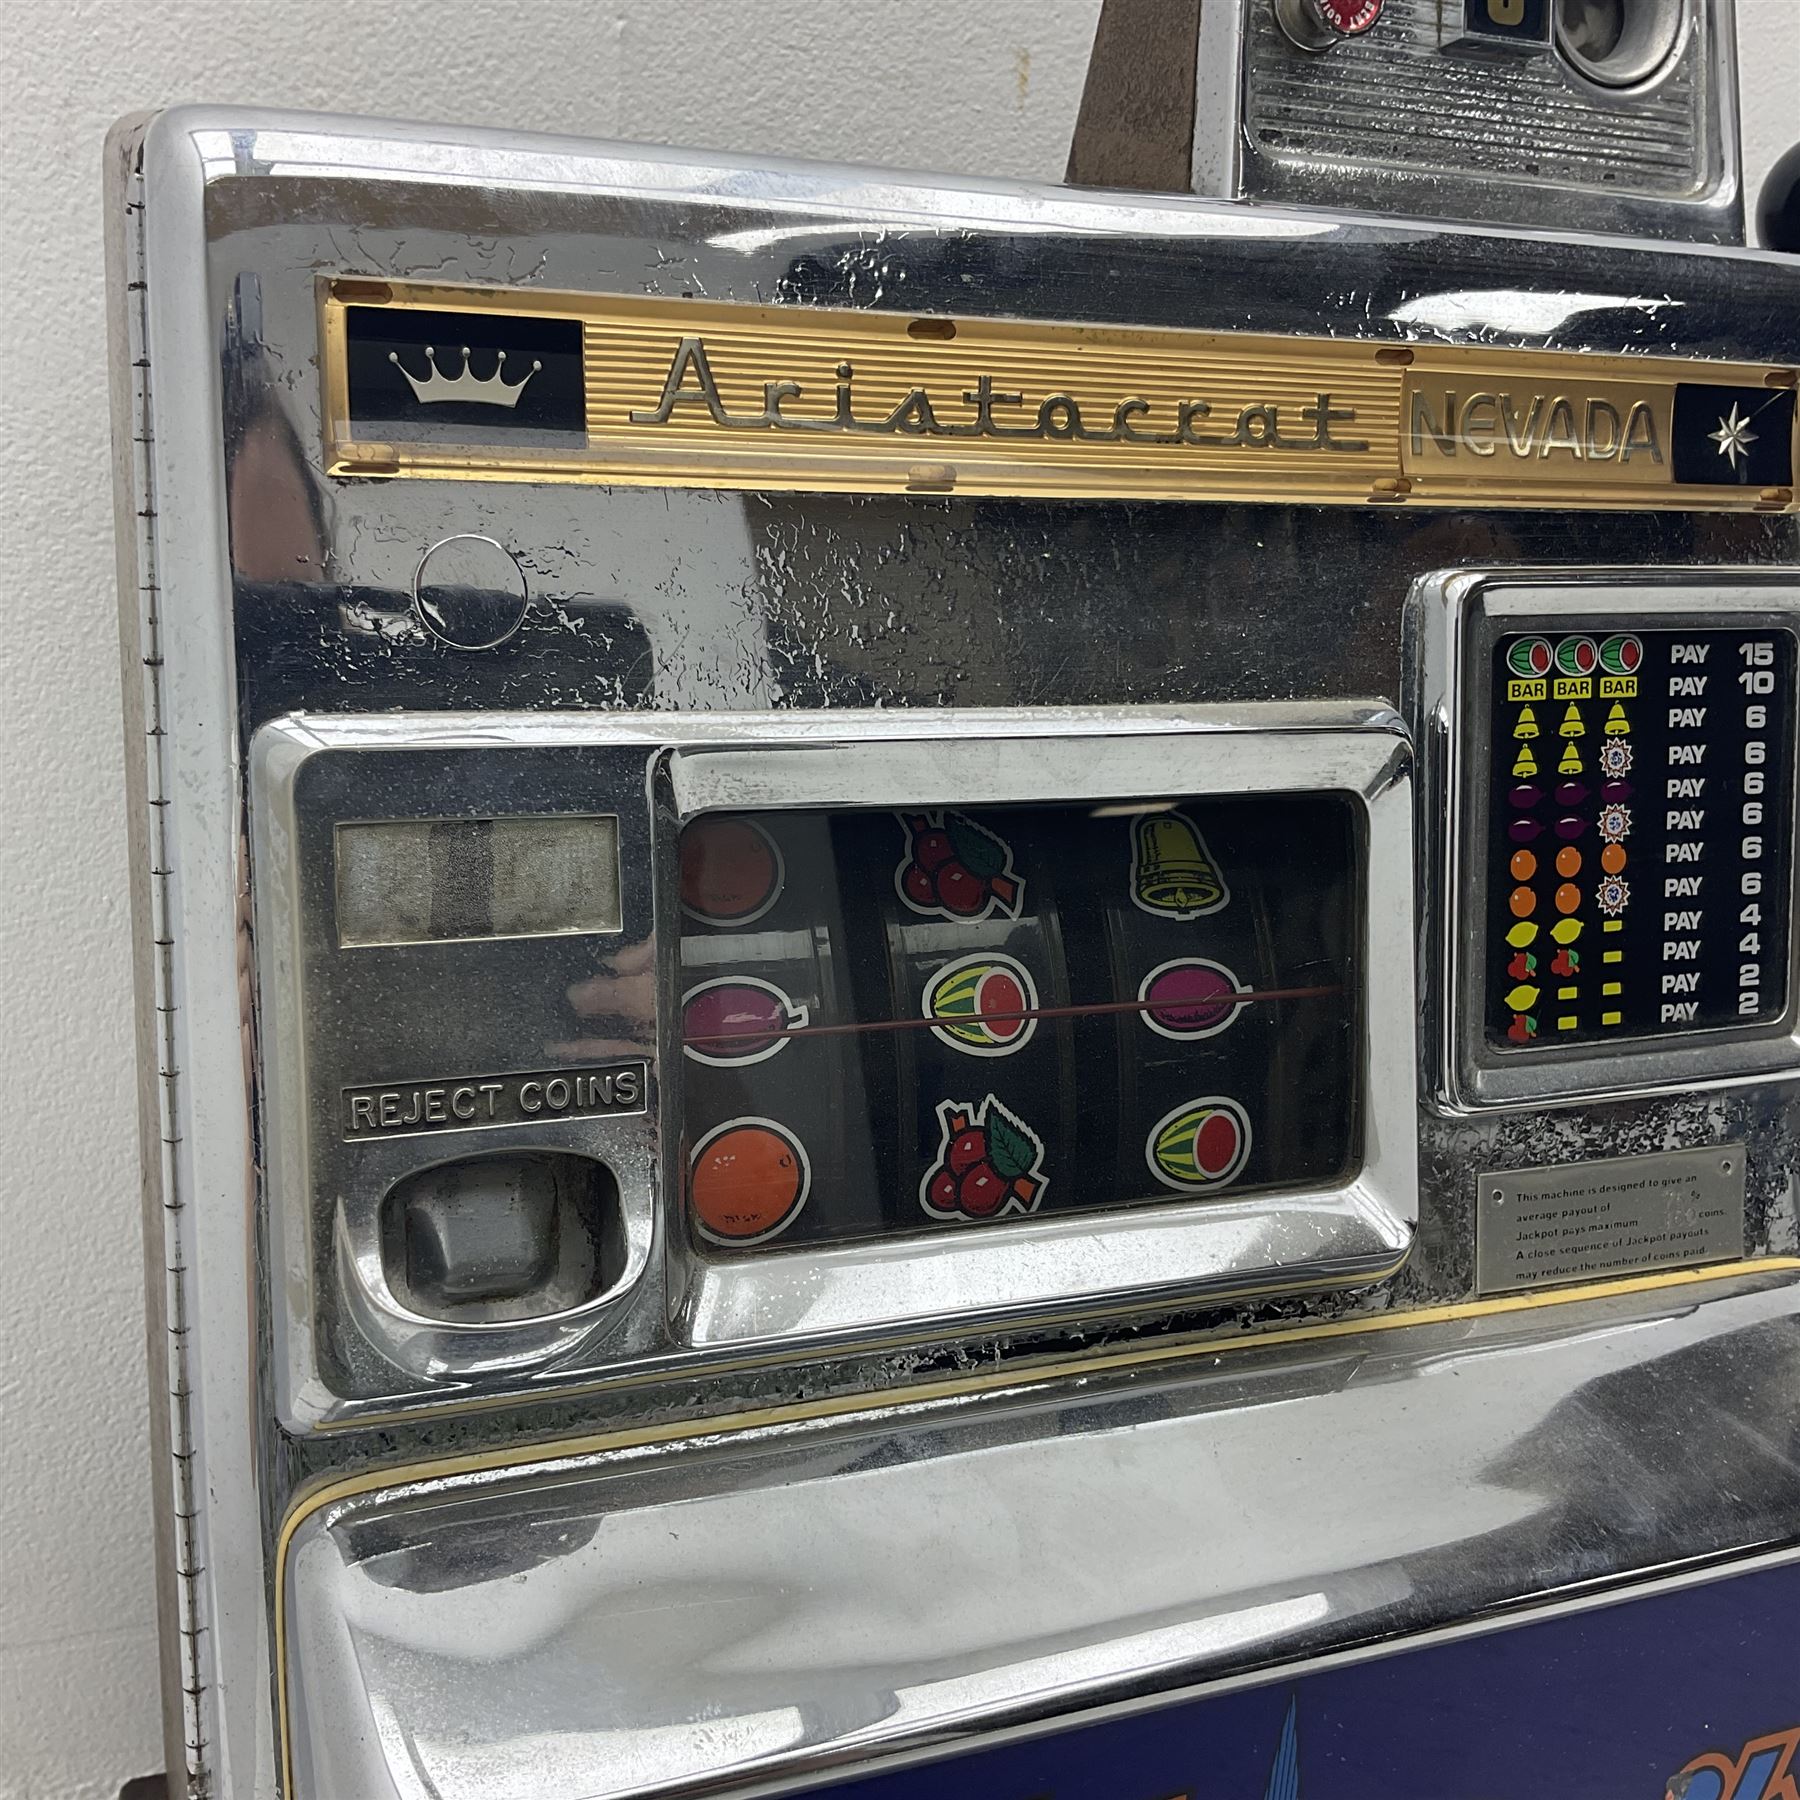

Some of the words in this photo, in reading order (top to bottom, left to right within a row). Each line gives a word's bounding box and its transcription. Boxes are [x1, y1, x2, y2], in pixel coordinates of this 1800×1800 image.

[629, 336, 1369, 453] Aristocrat
[1408, 389, 1664, 465] NEVADA
[1671, 645, 1710, 664] PAY
[1739, 643, 1773, 666] 15
[1511, 682, 1544, 697] BAR
[1557, 680, 1589, 696] BAR
[1603, 679, 1635, 694] BAR
[1669, 676, 1707, 696] PAY
[1738, 671, 1774, 695] 10
[1668, 707, 1707, 728] PAY
[1746, 705, 1766, 728] 6
[1668, 745, 1706, 765] PAY
[1745, 742, 1765, 764] 6
[1667, 778, 1705, 798] PAY
[1744, 772, 1764, 795] 6
[1666, 810, 1704, 830] PAY
[1743, 802, 1763, 824] 6
[1666, 842, 1704, 863] PAY
[1742, 836, 1762, 859] 6
[1665, 877, 1703, 897] PAY
[1741, 872, 1762, 895] 6
[1664, 911, 1702, 931] PAY
[1740, 903, 1761, 926] 4
[1663, 940, 1701, 960] PAY
[1739, 933, 1760, 955] 4
[1662, 972, 1700, 994] PAY
[1739, 964, 1760, 986] 2
[1661, 1002, 1699, 1023] PAY
[1738, 991, 1759, 1014] 2
[351, 1084, 503, 1129] REJECT
[519, 1071, 638, 1113] COINS
[1516, 1193, 1538, 1202] This
[1541, 1189, 1585, 1200] machine
[1588, 1187, 1597, 1195] is
[1599, 1180, 1645, 1193] designed
[1649, 1179, 1659, 1187] to
[1661, 1178, 1682, 1187] give
[1516, 1211, 1558, 1222] average
[1561, 1205, 1598, 1218] payout
[1600, 1203, 1611, 1212] of
[1516, 1228, 1558, 1241] Jackpot
[1562, 1227, 1586, 1237] pays
[1588, 1220, 1638, 1232] maximum
[1516, 1251, 1524, 1260] A
[1528, 1248, 1556, 1259] close
[1559, 1241, 1609, 1255] sequence
[1612, 1238, 1622, 1247] of
[1626, 1233, 1666, 1246] Jackpot
[1670, 1228, 1709, 1241] payouts
[1516, 1272, 1538, 1280] may
[1541, 1266, 1578, 1277] reduce
[1580, 1262, 1597, 1271] the
[1600, 1257, 1639, 1268] number
[1642, 1253, 1651, 1262] of
[1654, 1251, 1680, 1260] coins
